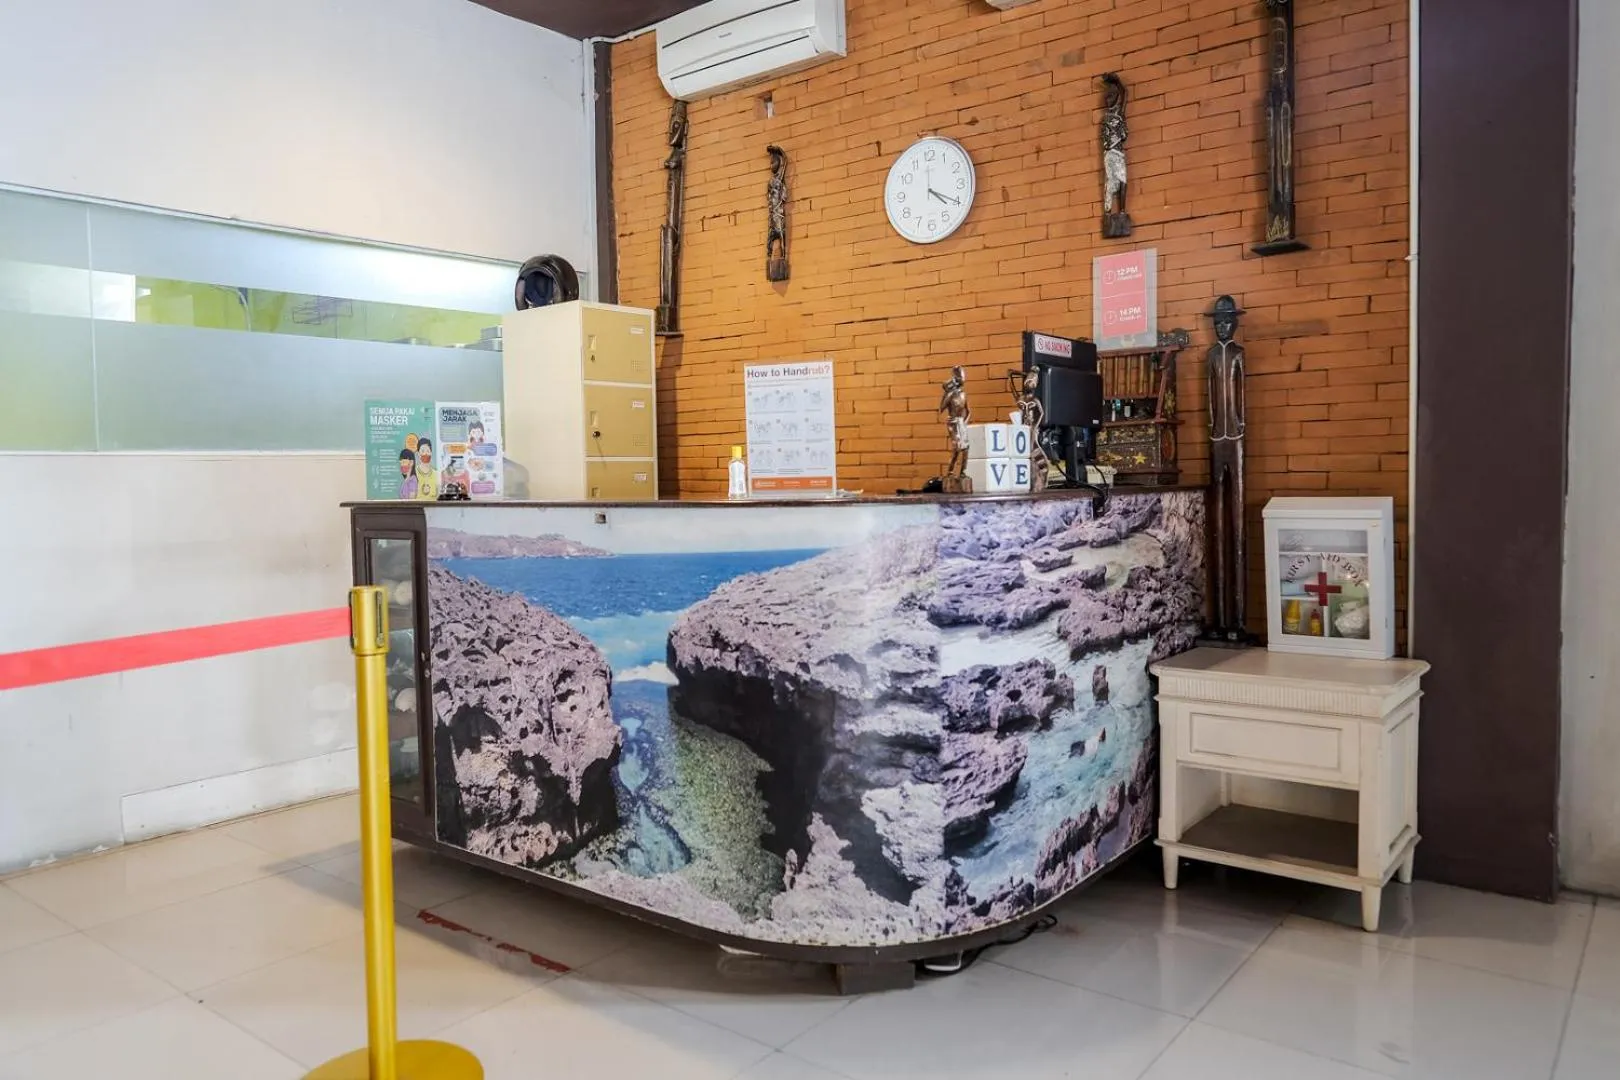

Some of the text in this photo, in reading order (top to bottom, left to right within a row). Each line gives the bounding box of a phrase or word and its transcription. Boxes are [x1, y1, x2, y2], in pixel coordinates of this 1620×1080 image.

[924, 149, 936, 162] 12
[912, 159, 919, 171] 11
[951, 161, 961, 174] 2
[901, 172, 913, 185] 10
[956, 177, 966, 190] 3
[896, 191, 906, 204] 9
[952, 195, 962, 207] 4
[902, 206, 912, 219] 8
[941, 210, 951, 223] 5
[915, 216, 923, 229] 7
[927, 219, 937, 232] 6
[1126, 265, 1138, 274] PM
[1128, 305, 1142, 315] PM
[747, 365, 831, 378] How to Handrub?
[442, 409, 479, 417] MENJAGA
[370, 415, 409, 426] MASKER
